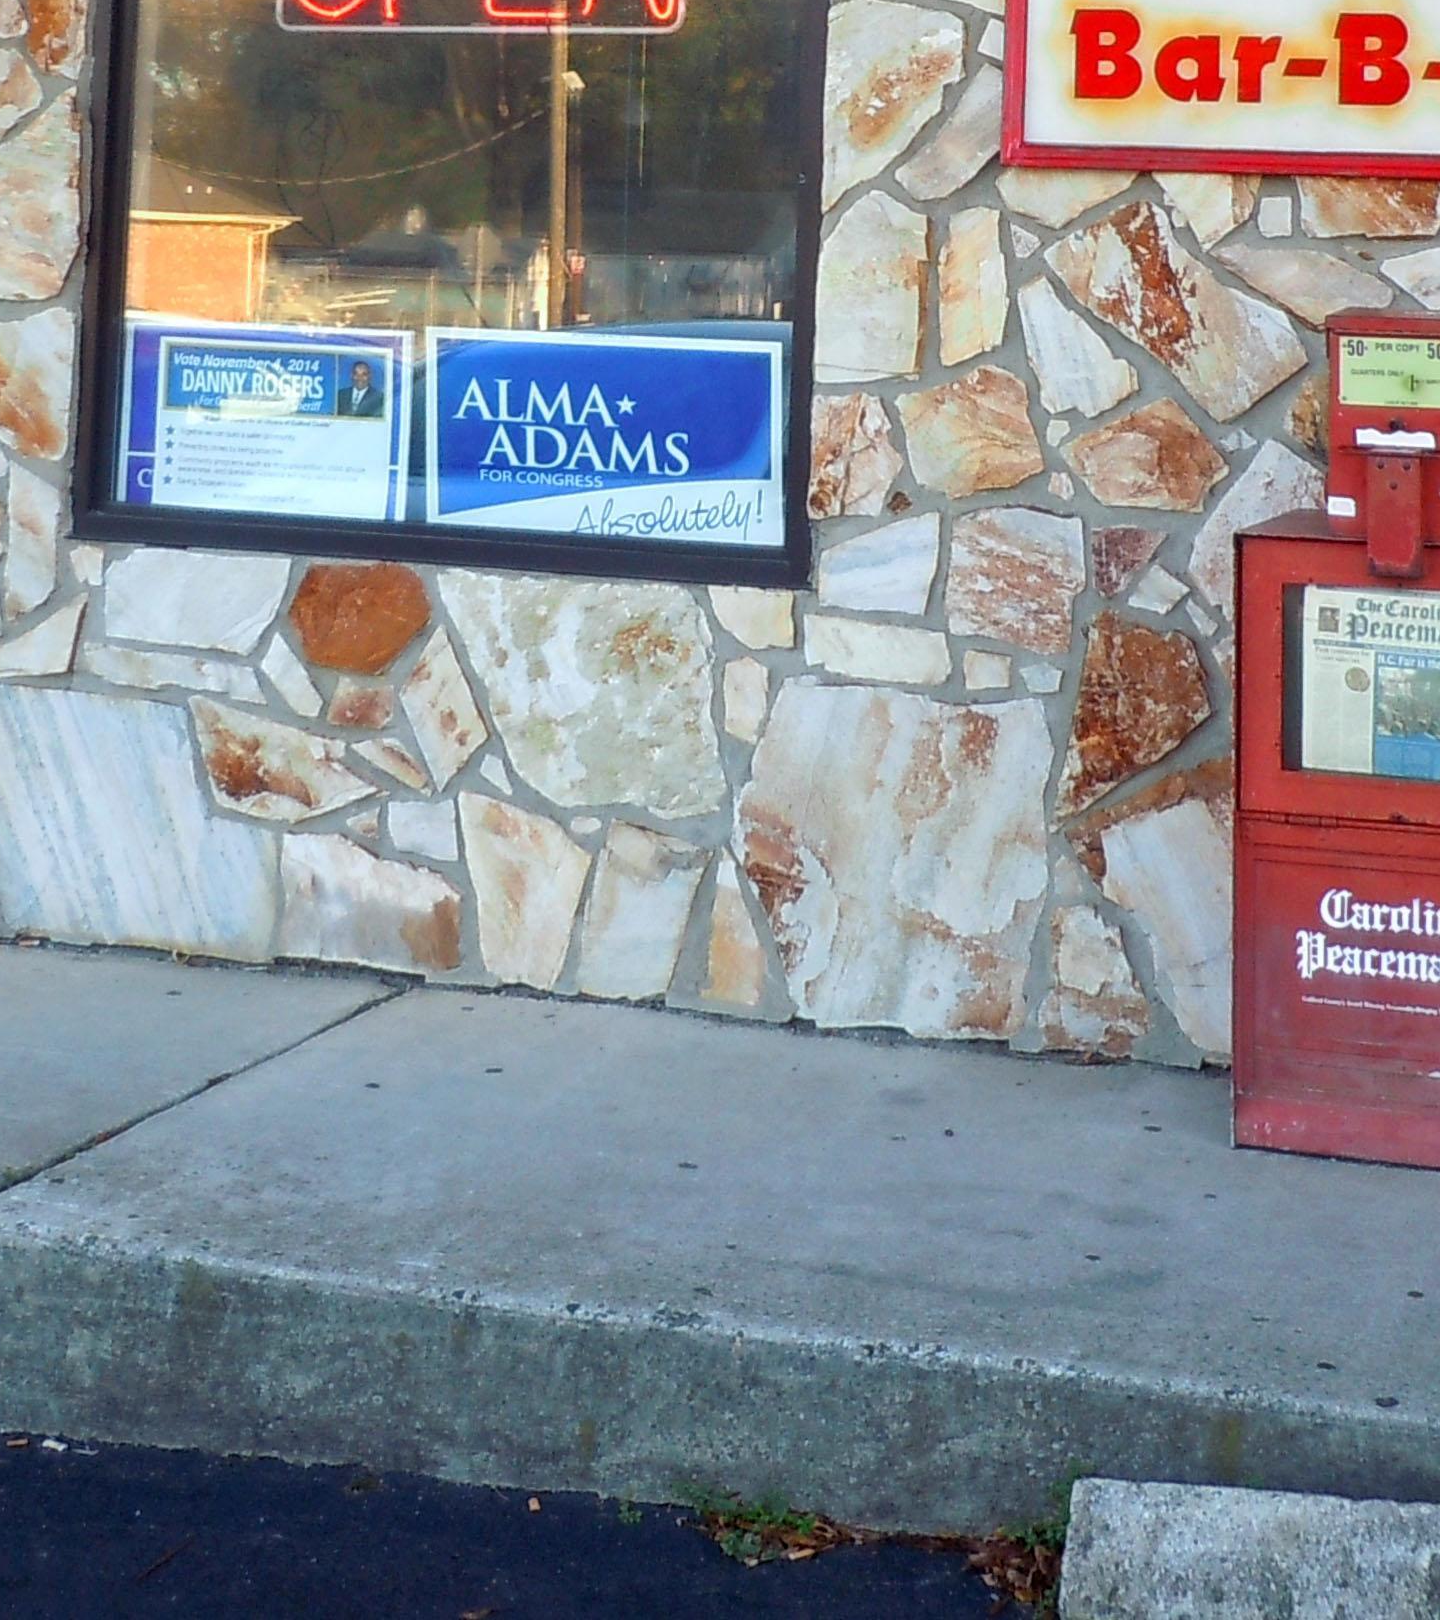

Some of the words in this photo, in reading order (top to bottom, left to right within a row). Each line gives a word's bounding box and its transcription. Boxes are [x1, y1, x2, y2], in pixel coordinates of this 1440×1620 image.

[1375, 342, 1393, 352] PER
[1395, 343, 1421, 353] COPY
[174, 352, 200, 366] Vote
[203, 354, 269, 370] November
[288, 358, 320, 372] 2014
[182, 369, 248, 395] DANNY
[252, 372, 324, 400] ROGERS
[453, 376, 620, 428] ALMA
[479, 424, 691, 477] ADAMS
[480, 468, 513, 482] FOR
[515, 470, 603, 488] CONGRESS
[572, 488, 763, 541] Absolutely!
[1356, 597, 1383, 613] The
